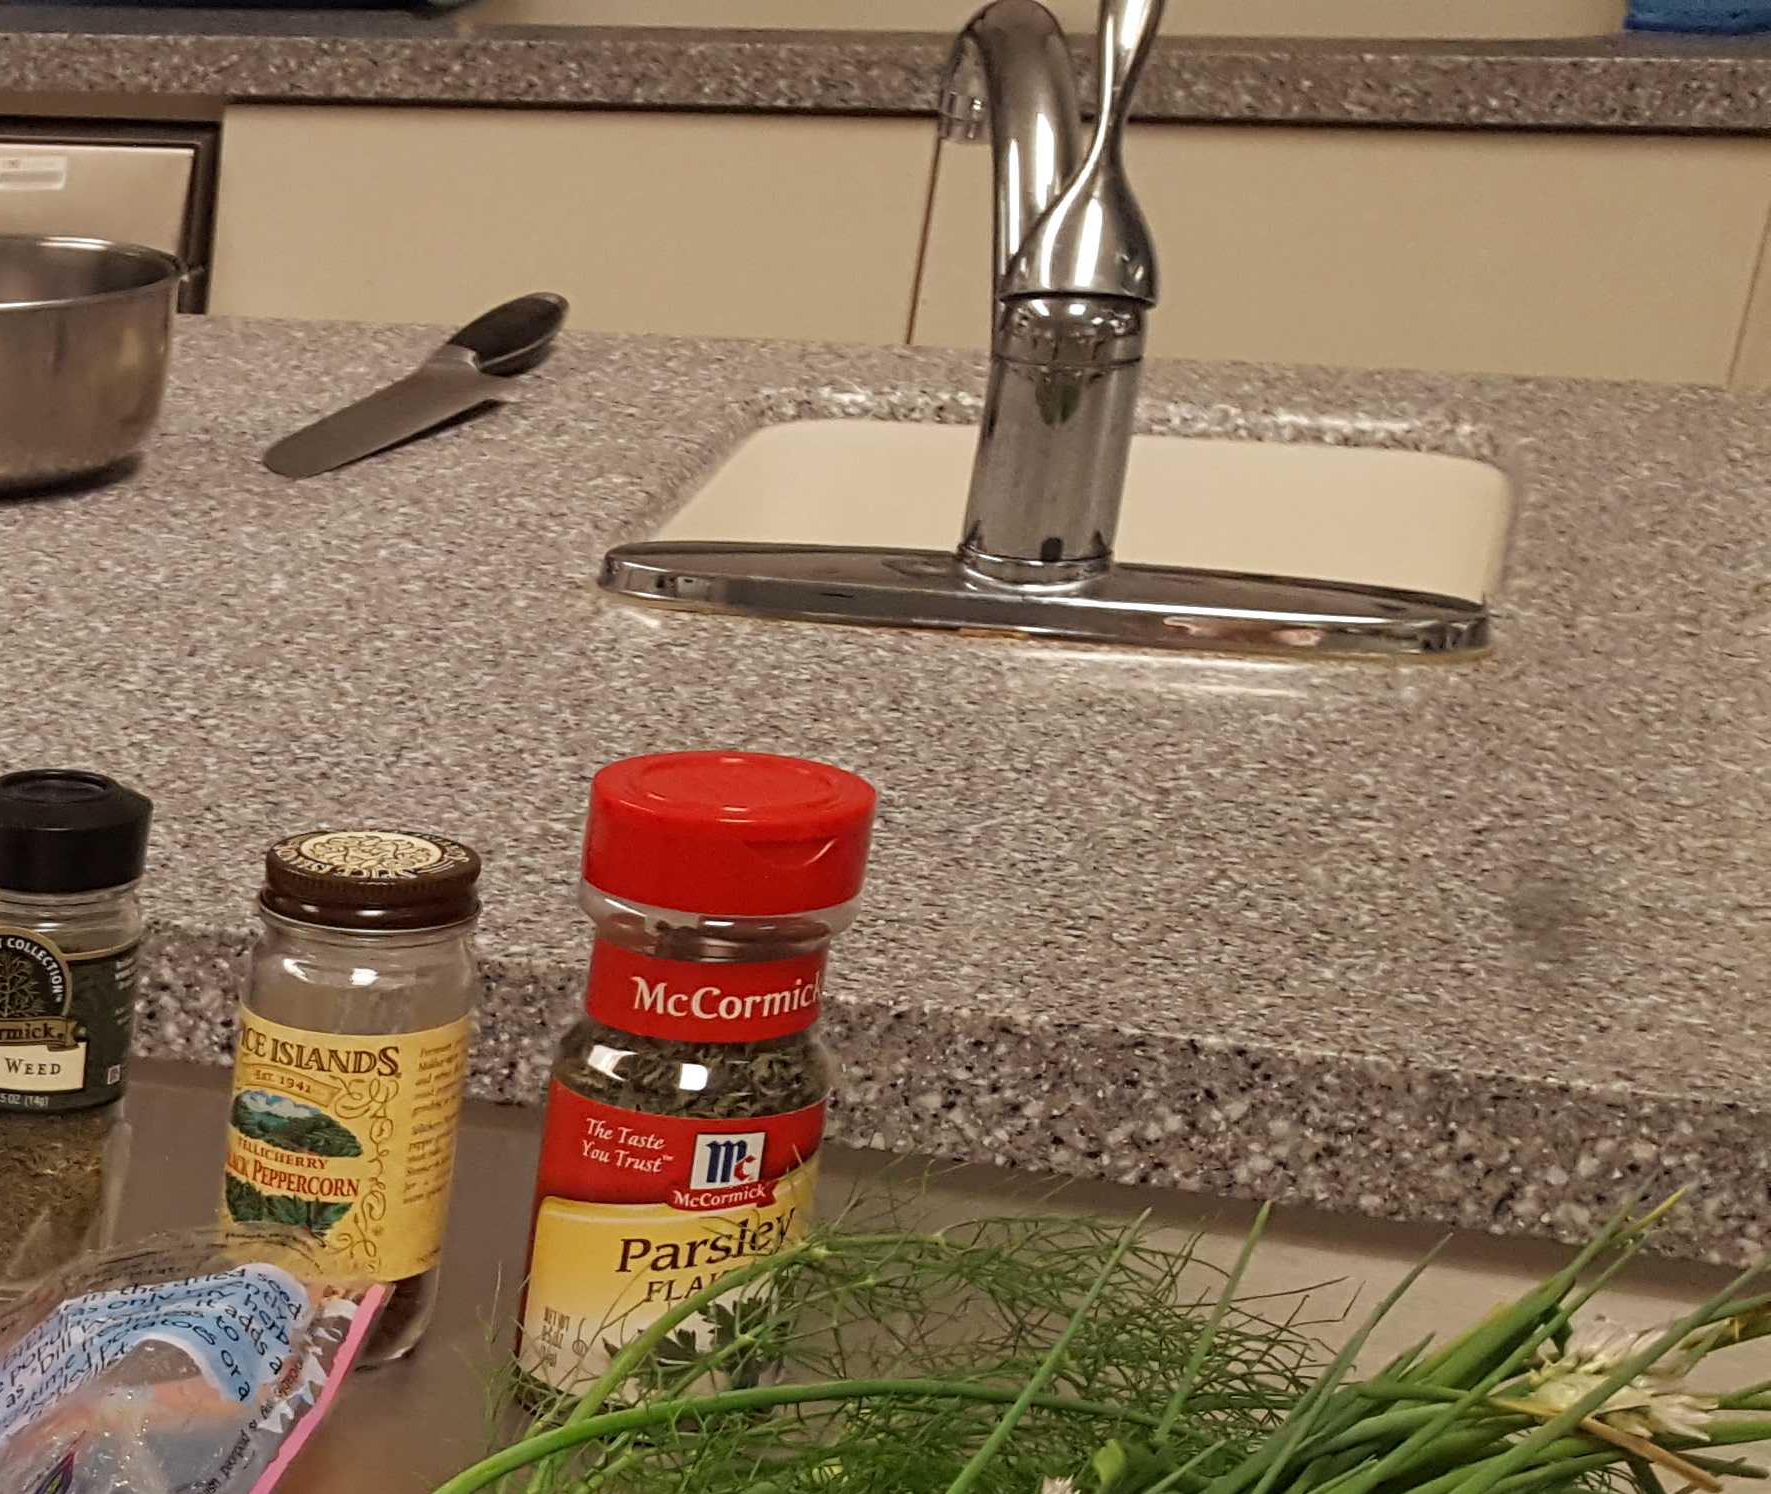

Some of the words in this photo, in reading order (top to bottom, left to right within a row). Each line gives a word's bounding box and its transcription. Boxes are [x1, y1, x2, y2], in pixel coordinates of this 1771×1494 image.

[631, 976, 822, 1020] McCormick
[5, 1057, 62, 1076] WEED
[270, 1038, 401, 1078] ISLANDS
[581, 1138, 611, 1164] You
[586, 1118, 613, 1140] The
[618, 1126, 666, 1151] Taste
[252, 1158, 360, 1198] PEPPERCORN
[672, 1181, 765, 1209] McCormick
[615, 1206, 795, 1273] Parsley
[257, 1272, 303, 1321] seed
[216, 1315, 240, 1342] to
[6, 1383, 25, 1409] as
[225, 1304, 269, 1357] adds
[269, 1356, 283, 1375] a
[220, 1350, 242, 1377] or
[237, 1381, 251, 1402] a
